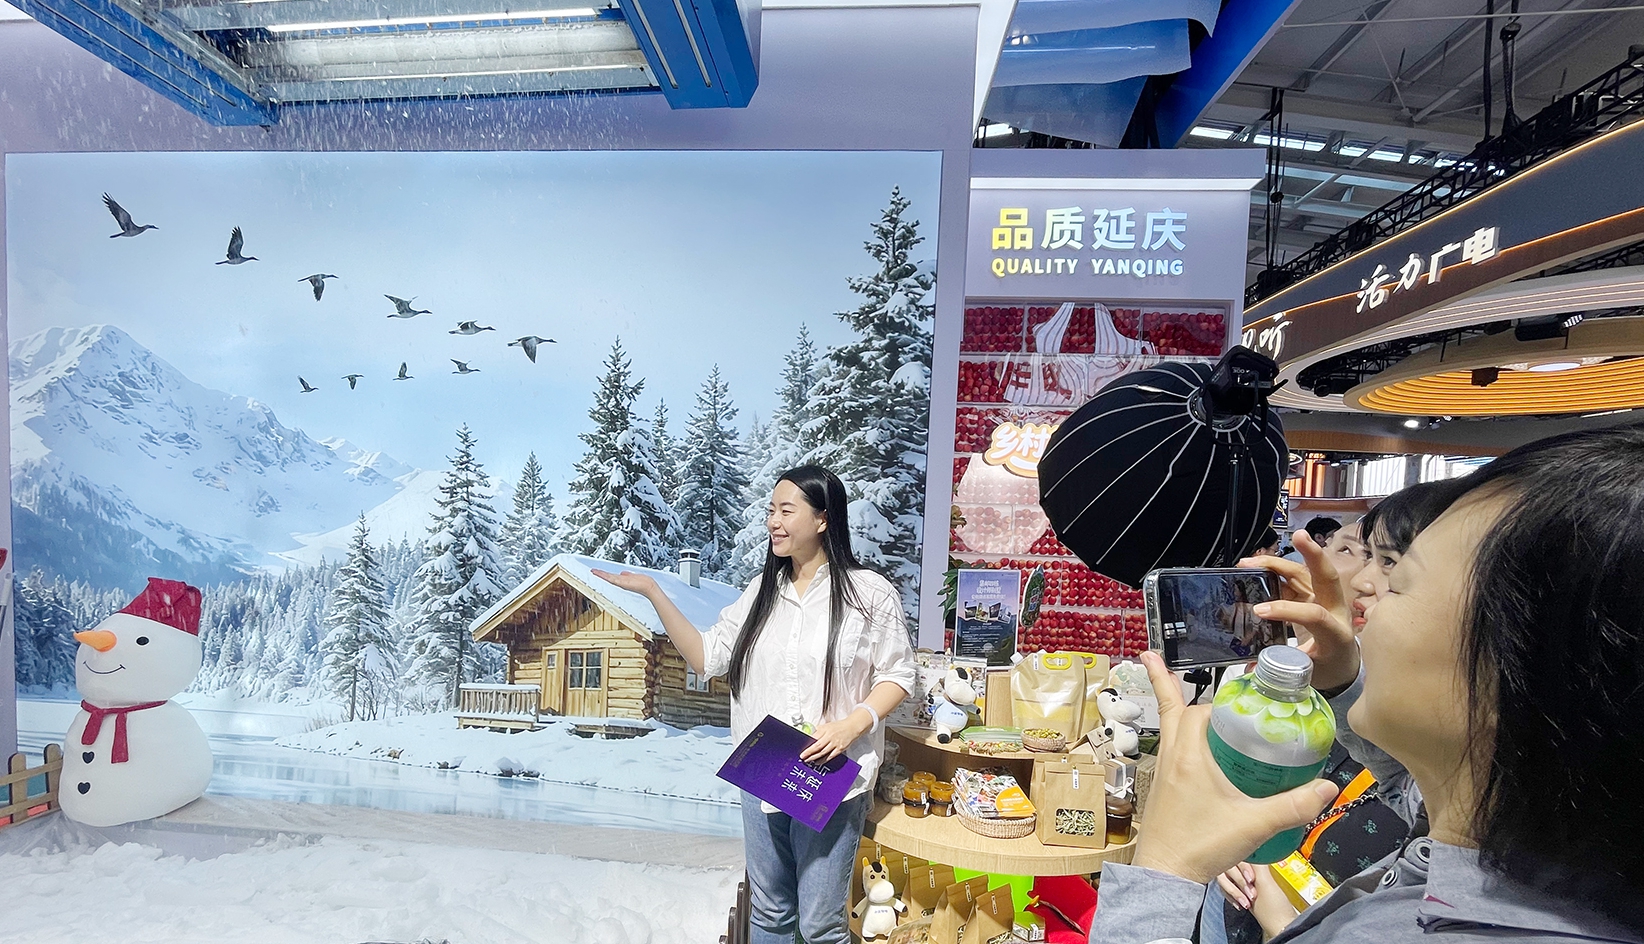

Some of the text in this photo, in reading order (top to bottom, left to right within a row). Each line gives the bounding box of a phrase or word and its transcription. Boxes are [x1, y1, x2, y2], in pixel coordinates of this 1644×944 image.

[991, 206, 1188, 251] 品质延庆
[991, 257, 1185, 278] QUALITY YANQING
[1355, 226, 1498, 315] 活力广电
[990, 425, 1052, 459] 乡村
